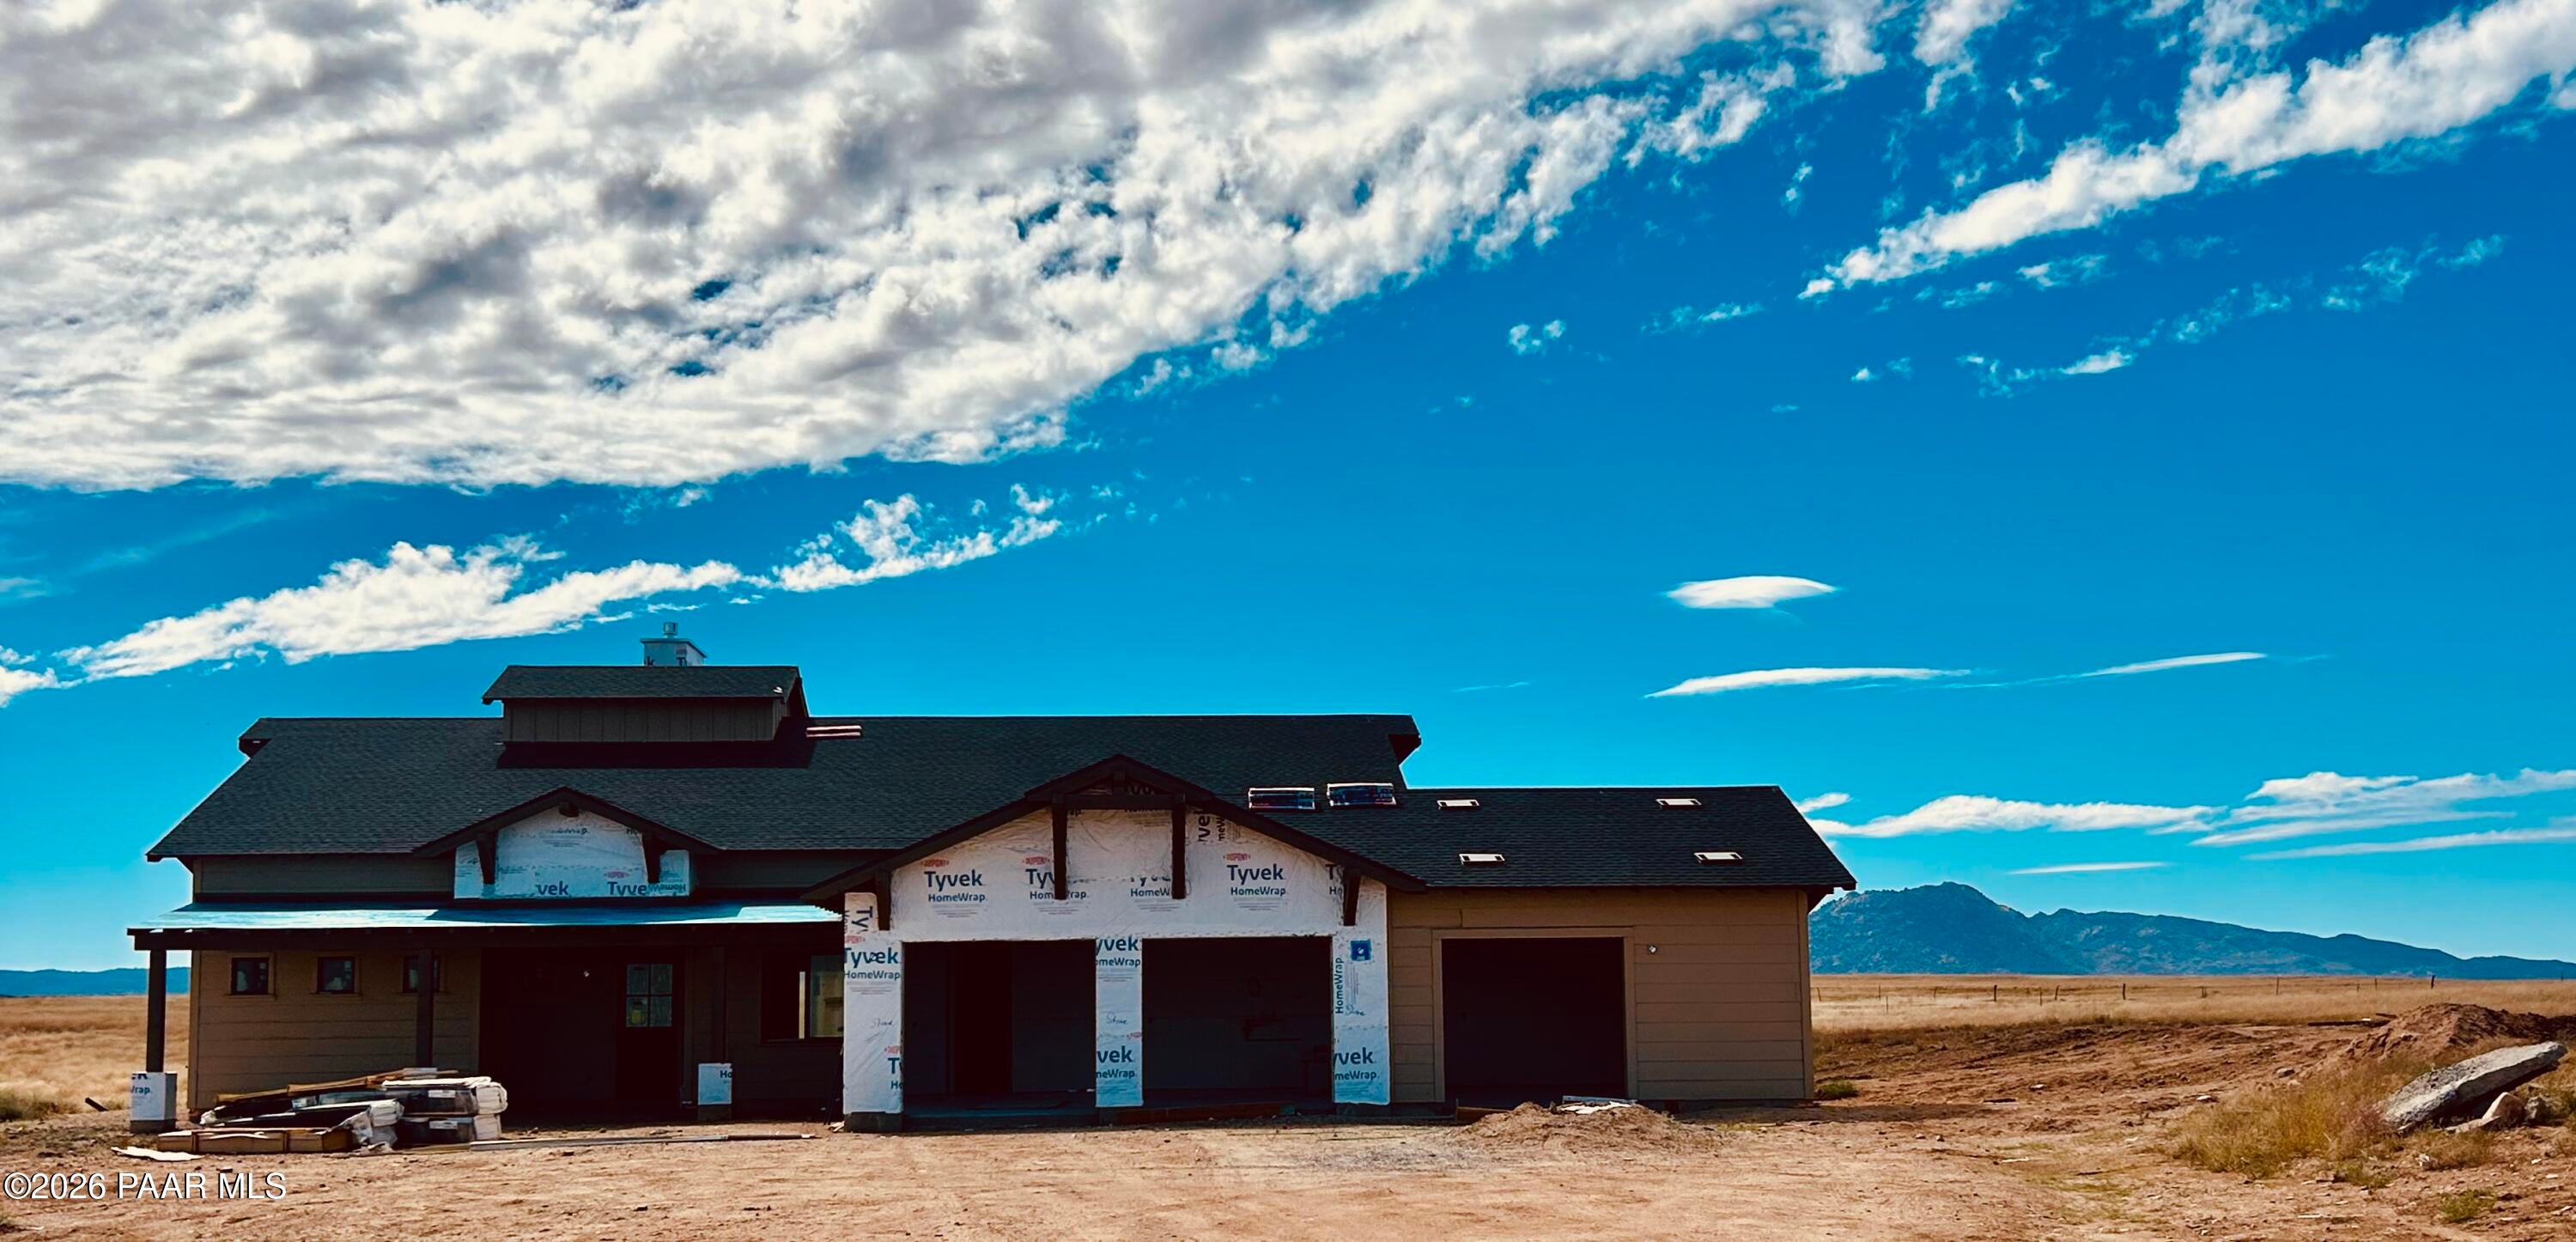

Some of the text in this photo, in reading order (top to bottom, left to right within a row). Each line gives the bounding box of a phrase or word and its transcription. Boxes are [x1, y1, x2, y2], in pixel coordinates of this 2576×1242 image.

[924, 868, 982, 892] Tyvek
[1226, 863, 1284, 886] Tyvek
[928, 893, 986, 903] HomeWrap
[1230, 886, 1286, 897] HomeWrap
[1334, 957, 1345, 1014] HomeWrap
[1097, 1045, 1133, 1063] vek
